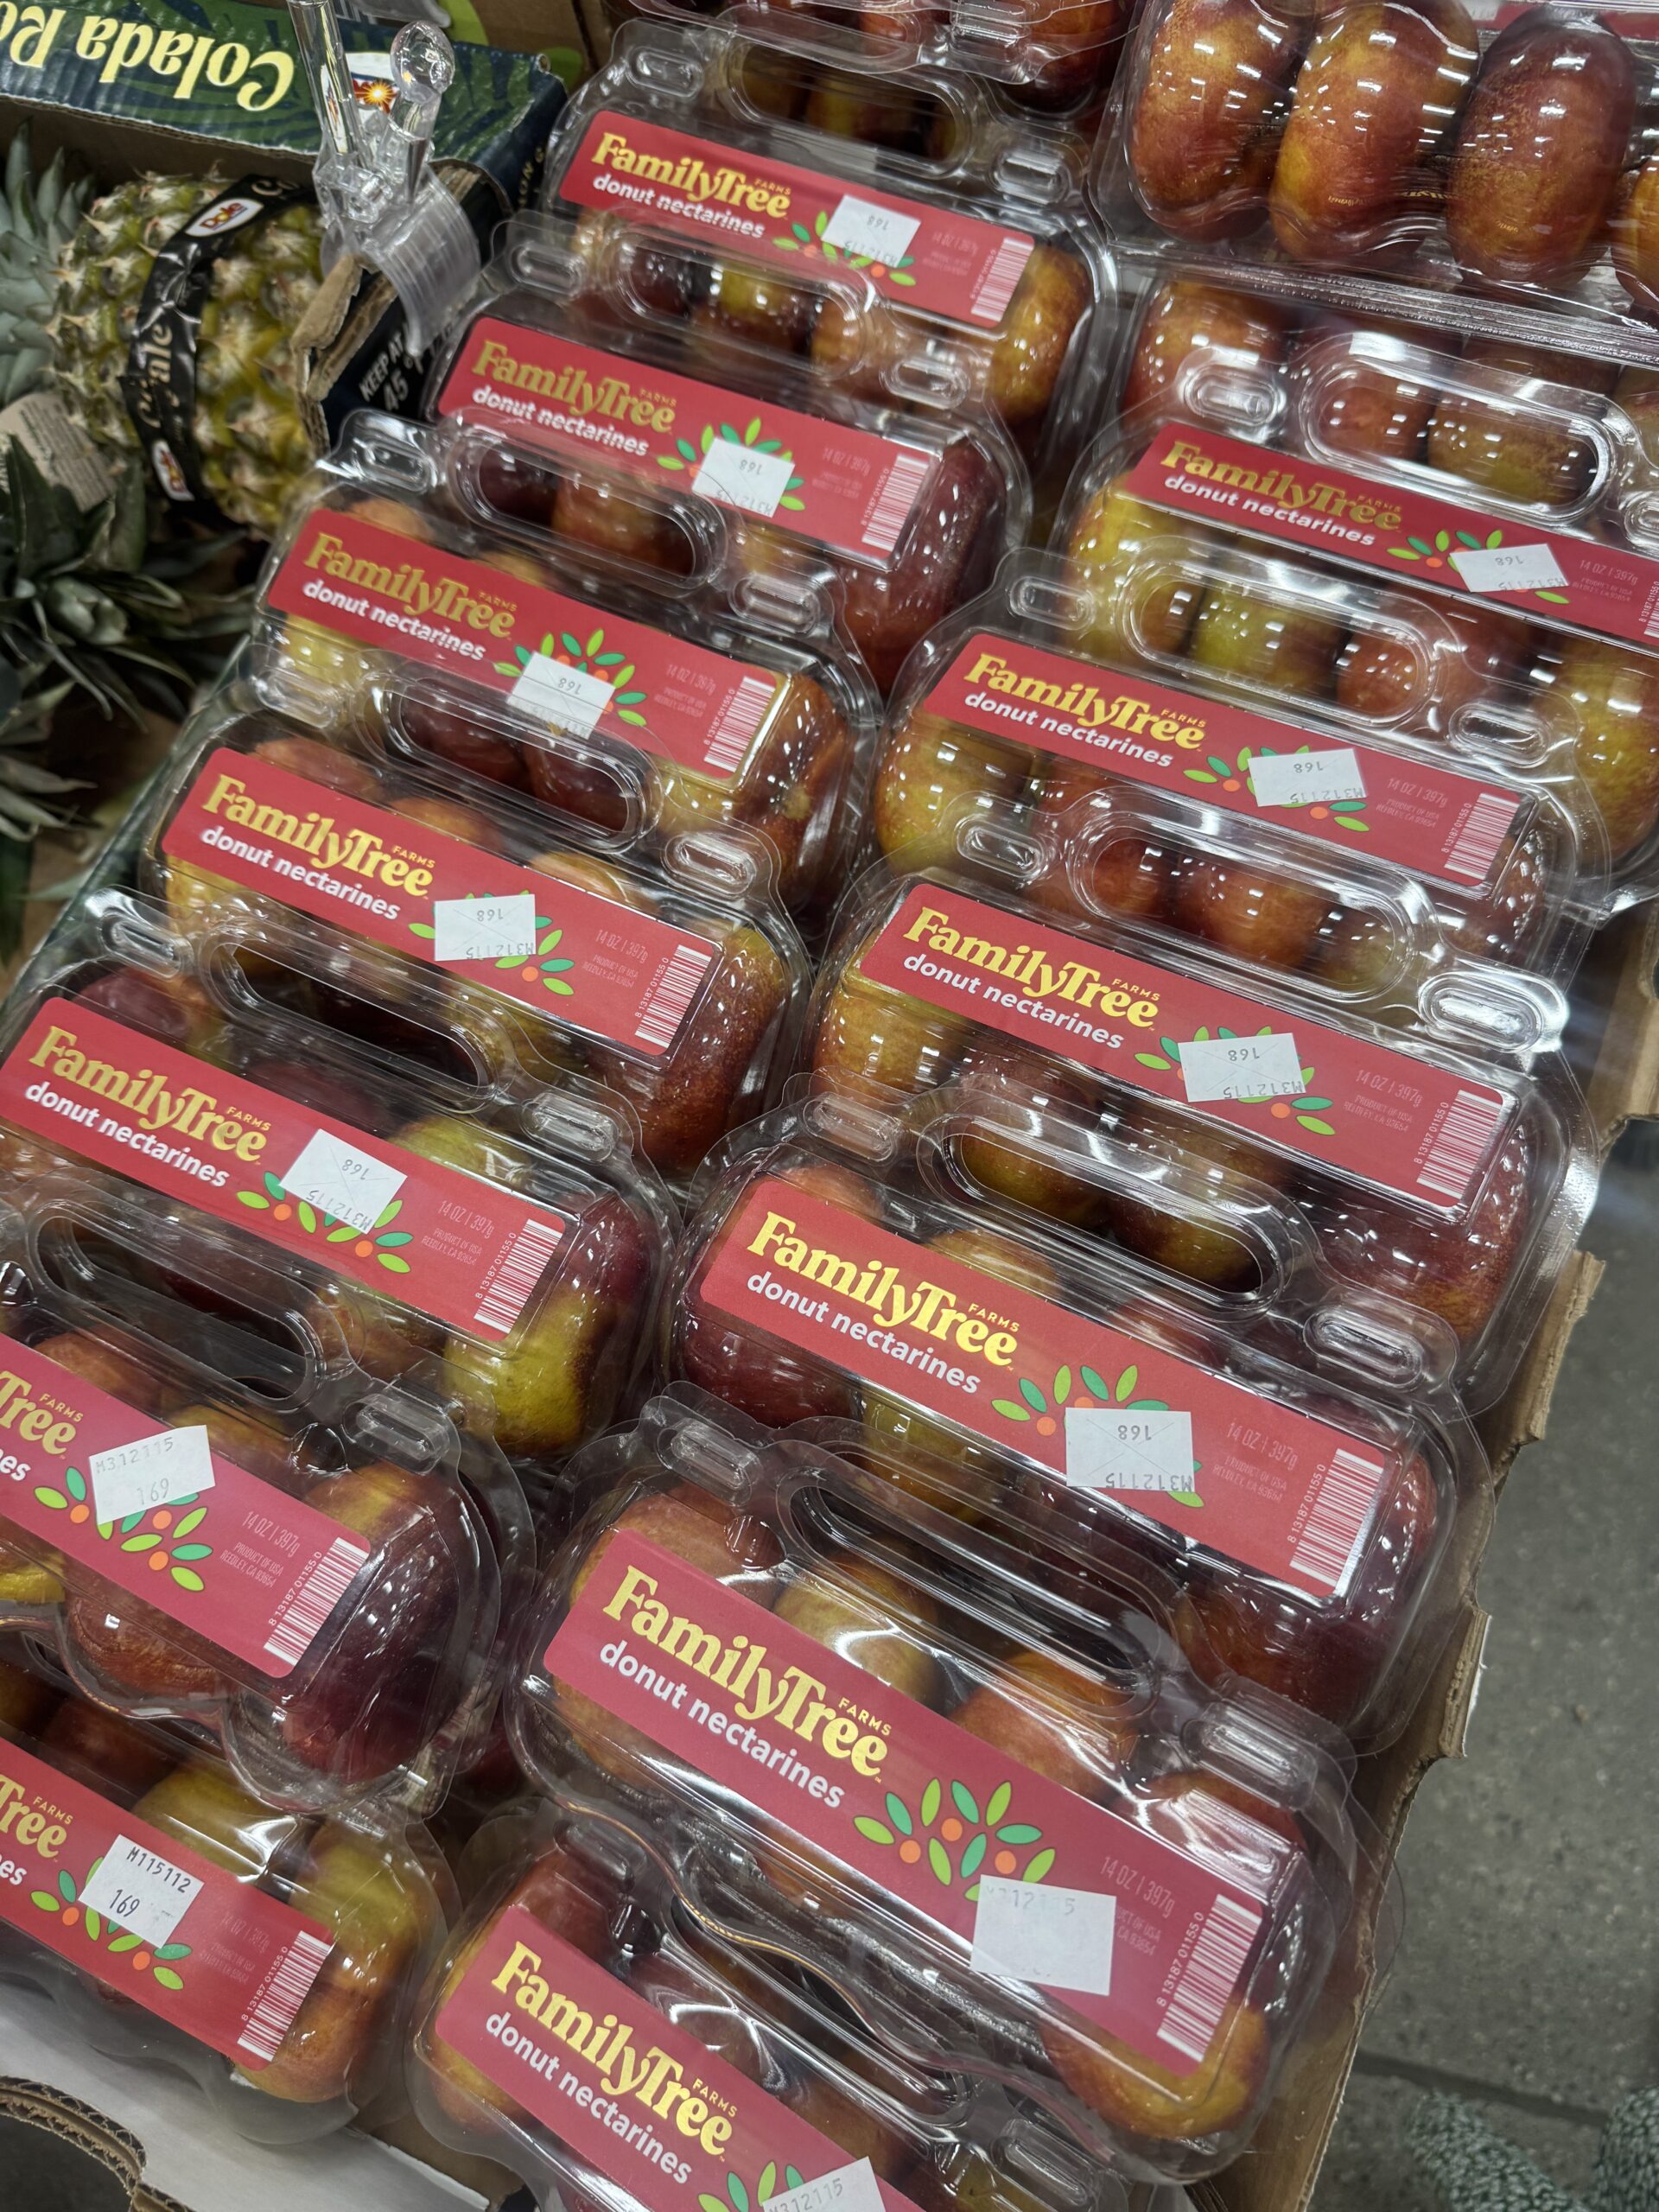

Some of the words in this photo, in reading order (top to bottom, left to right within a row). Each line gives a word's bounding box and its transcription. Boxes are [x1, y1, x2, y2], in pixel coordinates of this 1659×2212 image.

[76, 16, 294, 111] Colada
[590, 132, 791, 217] FamilyTree
[753, 178, 792, 195] FARMS
[594, 173, 655, 203] donut
[657, 194, 766, 237] nectarines
[867, 214, 889, 231] 168
[359, 352, 389, 402] KEEP
[384, 368, 409, 411] 45
[471, 338, 677, 431] FamilyTree
[474, 385, 536, 419] donut
[537, 409, 649, 454] nectarines
[740, 460, 763, 475] 168
[1159, 442, 1403, 529] FamilyTree
[1164, 476, 1238, 506] donut
[1241, 499, 1376, 545] nectarines
[1495, 555, 1524, 567] 168
[302, 531, 517, 637] FamilyTree
[302, 578, 369, 616] donut
[369, 607, 486, 659] nectarines
[558, 677, 582, 696] 168
[962, 654, 1206, 748] FamilyTree
[963, 692, 1038, 725] donut
[1039, 717, 1174, 766] nectarines
[1160, 709, 1207, 728] FARMS
[1294, 760, 1324, 774] 168
[199, 773, 435, 895] FamilyTree
[1444, 827, 1460, 849] 13187
[1452, 807, 1469, 829] 01155
[199, 825, 272, 868] donut
[273, 858, 402, 919] nectarines
[391, 844, 436, 869] FARMS
[477, 908, 504, 922] 168
[639, 987, 655, 1012] 13187
[649, 963, 666, 988] 01155
[902, 907, 1160, 1026] FamilyTree
[903, 953, 981, 994] donut
[982, 985, 1125, 1048] nectarines
[1110, 977, 1161, 1002] FARMS
[1227, 1047, 1260, 1062] 168
[24, 1027, 269, 1160] FamilyTree
[1223, 1080, 1304, 1099] M312115
[1439, 1101, 1449, 1109] 0
[21, 1082, 98, 1128] donut
[96, 1118, 230, 1185] nectarines
[226, 1105, 273, 1132] FARMS
[1427, 1107, 1446, 1134] 01155
[1414, 1157, 1425, 1166] 8
[1417, 1132, 1436, 1158] 13187
[341, 1159, 370, 1180] 168
[306, 1189, 373, 1232] M312115
[435, 1199, 453, 1217] 14
[448, 1205, 467, 1224] OZ
[468, 1213, 495, 1240] 397g
[479, 1265, 499, 1292] 13187
[493, 1238, 513, 1267] 01155
[507, 1231, 518, 1240] 0
[746, 1211, 1020, 1364] FamilyTree
[747, 1270, 829, 1323] donut
[830, 1313, 982, 1394] nectarines
[967, 1302, 1021, 1334] FARMS
[40, 1393, 84, 1422] FARMS
[1117, 1424, 1152, 1441] 168
[95, 1436, 175, 1474] M312115
[1315, 1462, 1327, 1473] 0
[137, 1478, 169, 1505] 169
[1105, 1471, 1192, 1492] M312115
[1302, 1471, 1324, 1504] 01155
[240, 1510, 260, 1530] 14
[252, 1516, 274, 1538] OZ
[272, 1528, 301, 1558] 397g
[1286, 1534, 1298, 1544] 8
[1290, 1503, 1311, 1535] 13187
[266, 1617, 277, 1627] 8
[273, 1587, 298, 1618] 13187
[292, 1557, 318, 1589] 01155
[312, 1549, 323, 1560] 0
[600, 1567, 890, 1773] FamilyTree
[596, 1641, 685, 1709] donut
[683, 1698, 845, 1808] nectarines
[836, 1695, 893, 1738] FARMS
[33, 1796, 73, 1825] FARMS
[127, 1847, 192, 1893] M115112
[1098, 1854, 1117, 1880] 14
[1114, 1864, 1136, 1891] OZ
[1140, 1878, 1173, 1918] 397g
[109, 1889, 141, 1917] 169
[1190, 1909, 1202, 1923] 0
[1175, 1919, 1198, 1960] 01155
[239, 2012, 250, 2022] 8
[245, 1983, 268, 2013] 13187
[263, 1953, 286, 1985] 01155
[280, 1945, 290, 1955] 0
[1160, 1957, 1183, 1998] 13187
[1155, 1995, 1168, 2009] 8
[489, 1940, 735, 2154] FamilyTree
[484, 2012, 560, 2082] donut
[557, 2071, 693, 2185] nectarines
[690, 2077, 740, 2120] FARMS
